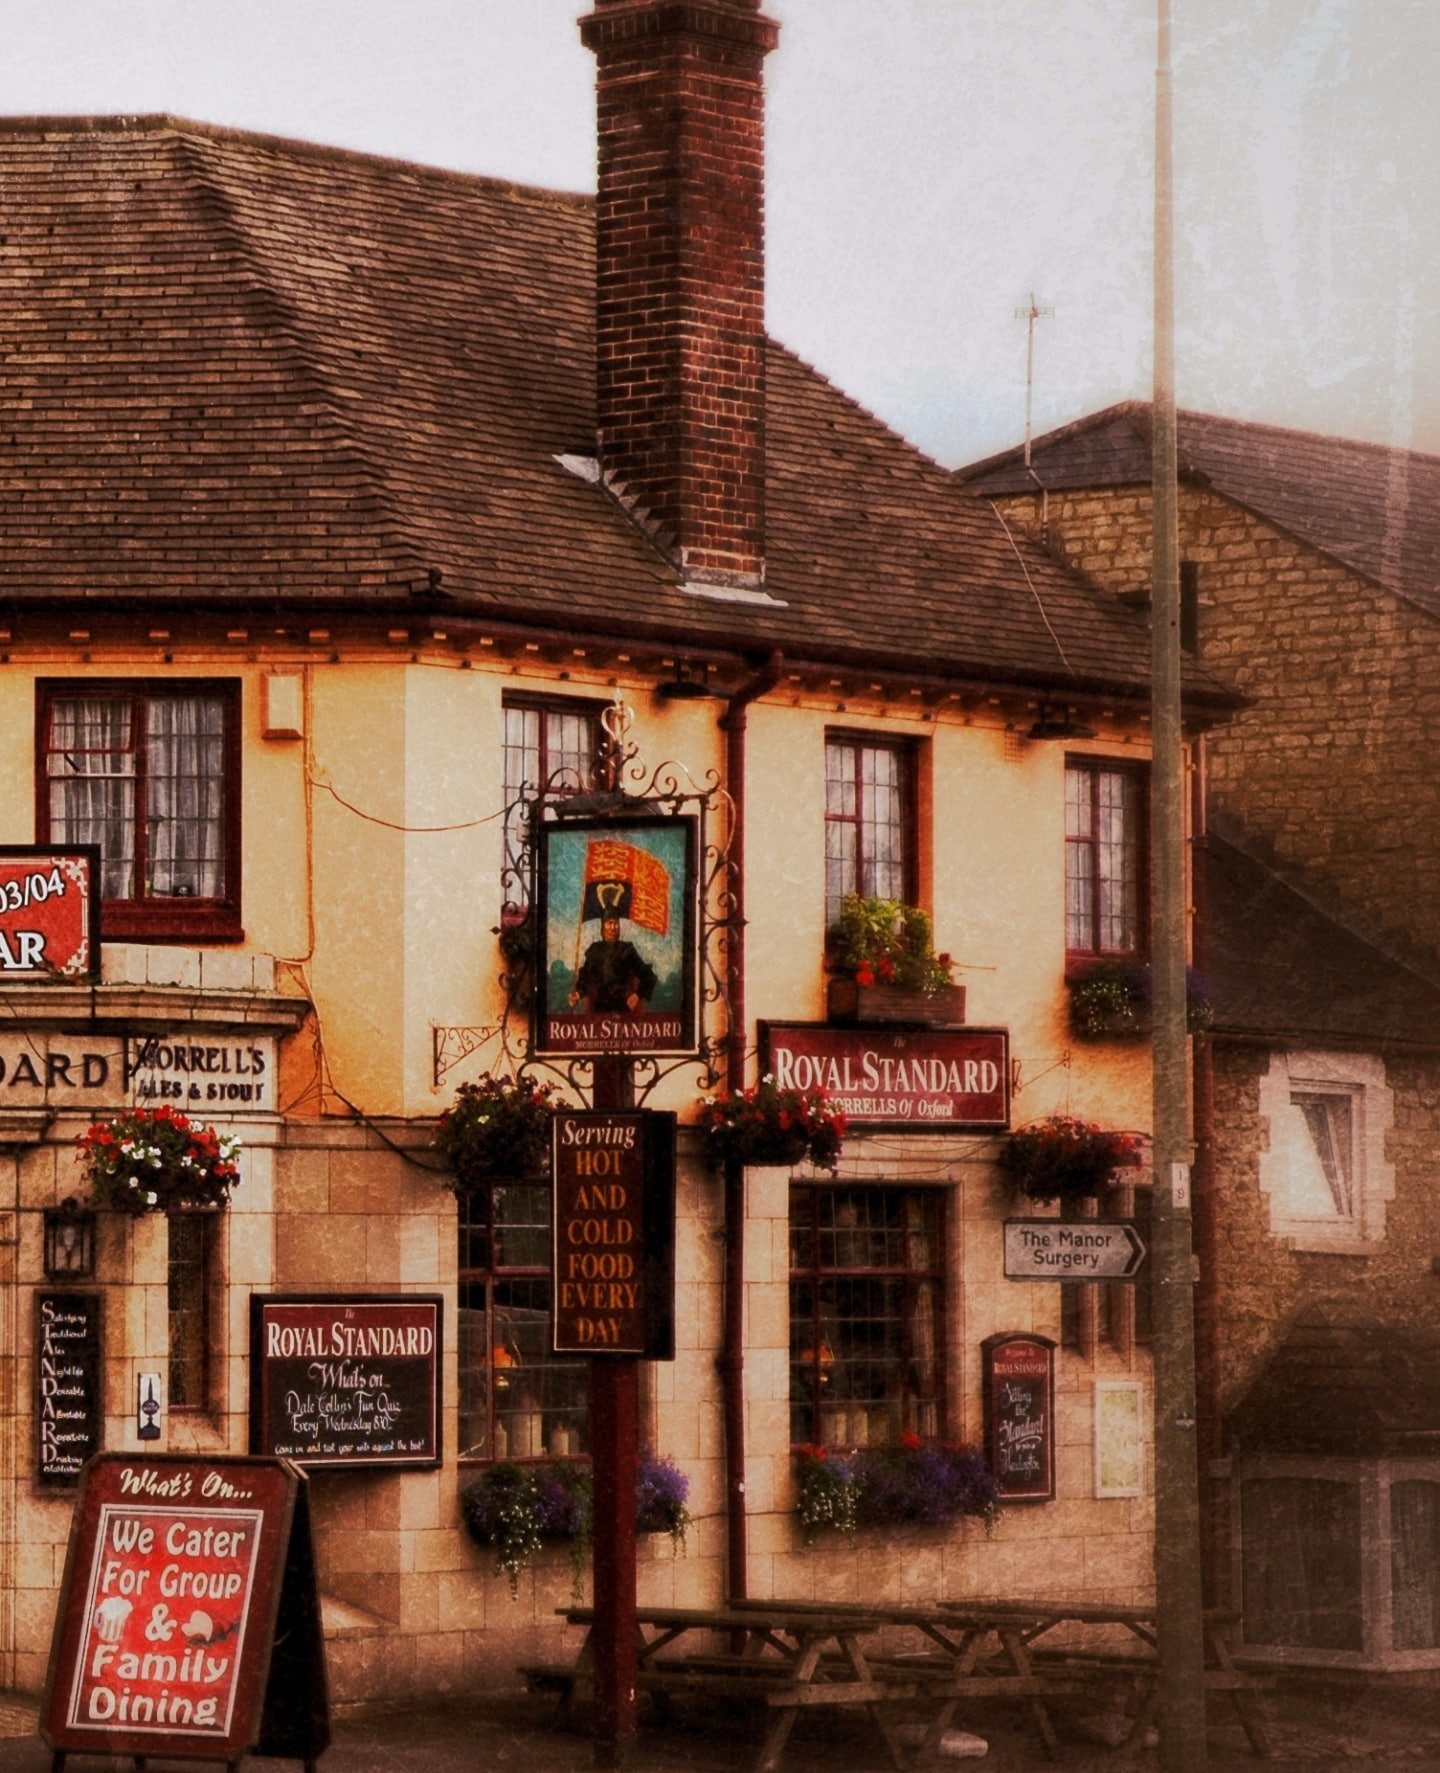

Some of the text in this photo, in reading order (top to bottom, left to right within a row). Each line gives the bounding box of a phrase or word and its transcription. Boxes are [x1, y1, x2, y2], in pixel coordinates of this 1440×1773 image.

[549, 1019, 682, 1040] ROYAL STANDARD
[775, 1047, 999, 1094] ROYAL STANDARD
[138, 1080, 265, 1102] ALES & STOUT
[828, 1097, 954, 1119] ORRELLS Of Oxford
[561, 1119, 637, 1149] Serving
[575, 1150, 625, 1176] HOT
[573, 1184, 627, 1211] AND
[567, 1218, 633, 1245] COLD
[1020, 1230, 1112, 1248] The Manor
[568, 1253, 635, 1279] FOOD
[1033, 1249, 1100, 1268] Surgery
[561, 1282, 640, 1309] EVERY
[266, 1321, 433, 1357] ROYAL STANDARD
[577, 1317, 624, 1343] DAY
[308, 1359, 367, 1389] What's
[284, 1390, 315, 1416] Dale
[353, 1390, 376, 1420] Fun
[376, 1392, 402, 1421] Quiz
[291, 1414, 319, 1439] Every
[319, 1413, 372, 1435] Wednesday
[999, 1414, 1045, 1448] Standard
[306, 1442, 321, 1454] and
[338, 1444, 354, 1455] your
[397, 1439, 407, 1451] the
[119, 1467, 192, 1498] What's
[112, 1519, 246, 1558] We Cater
[101, 1561, 243, 1600] For Group
[145, 1603, 178, 1642] &
[90, 1644, 229, 1684] Family
[88, 1686, 219, 1726] Dining
